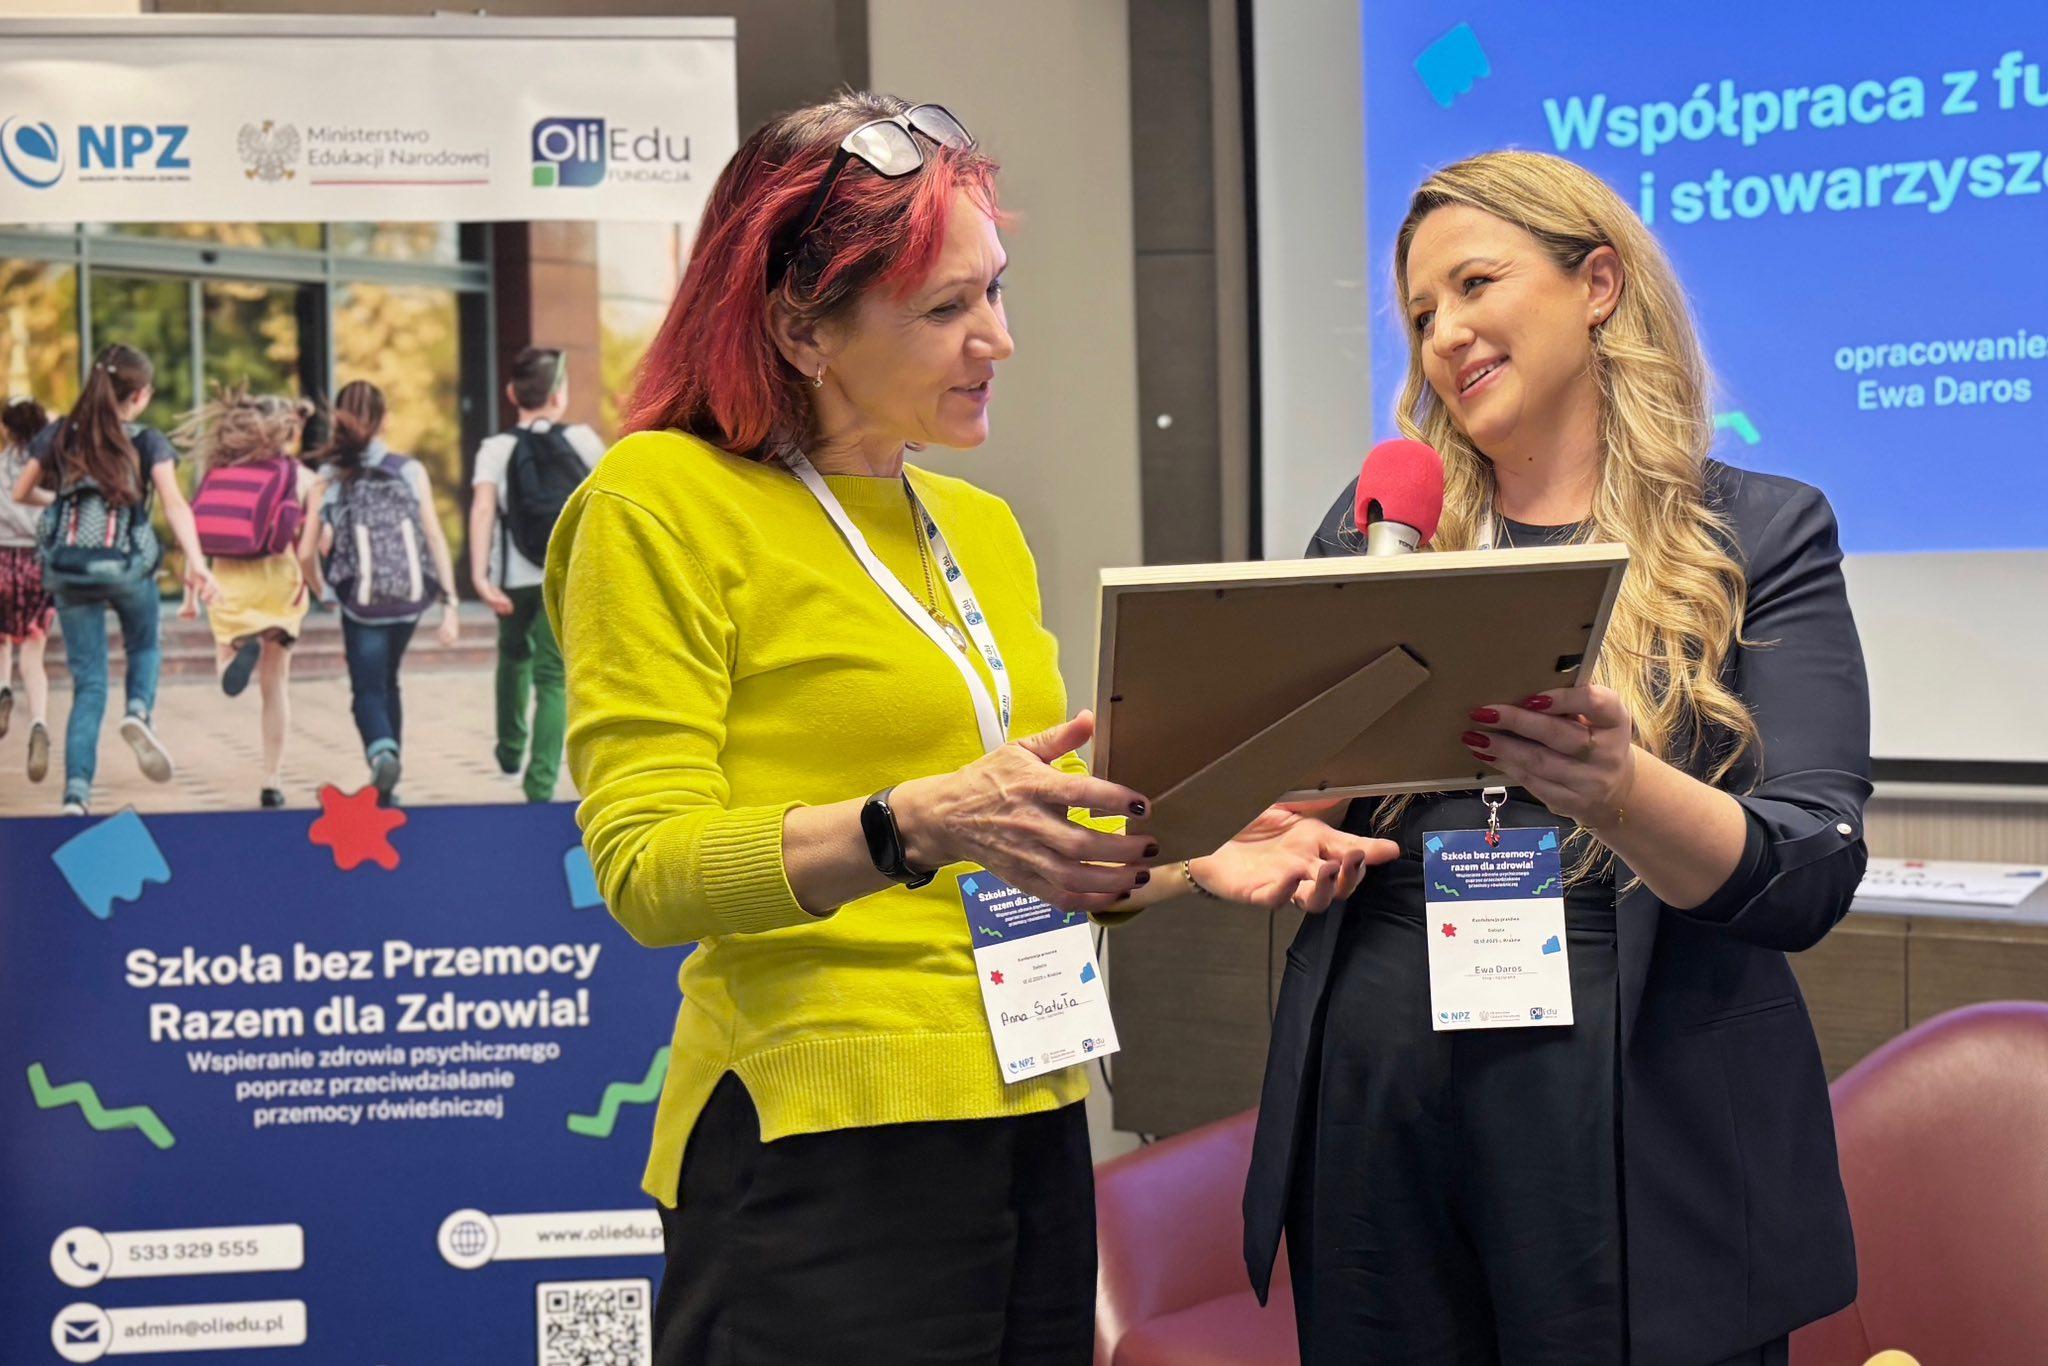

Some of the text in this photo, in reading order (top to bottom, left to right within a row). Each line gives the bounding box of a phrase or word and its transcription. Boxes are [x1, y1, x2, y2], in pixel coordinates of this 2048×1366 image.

[1543, 75, 1926, 156] Współpraca
[1940, 69, 1979, 116] z
[307, 126, 430, 144] Ministerstwo
[78, 124, 190, 169] NPZ
[308, 148, 490, 169] Edukacji Narodowej
[609, 169, 691, 182] FUNDACJA
[1640, 151, 2048, 227] i stowarzysz
[1834, 328, 2048, 375] opracowanie
[1857, 374, 2033, 411] Ewa Daros
[1441, 851, 1473, 861] Szkoła
[1474, 851, 1490, 860] bez
[1491, 850, 1535, 861] przemocy
[1450, 860, 1534, 872] razem dla zdrowia!
[978, 889, 1007, 902] Szkoła
[989, 900, 1015, 912] razem
[1014, 896, 1028, 907] dla
[125, 940, 601, 988] Szkoła bez Przemocy
[1474, 964, 1523, 974] Ewa Daros
[150, 988, 590, 1042] Razem dla Zdrowia!
[1001, 1012, 1029, 1026] Anna
[1451, 1011, 1471, 1020] NPZ
[186, 1040, 561, 1075] Wspieranie zdrowia psychicznego
[1018, 1056, 1036, 1069] NPZ
[236, 1067, 515, 1102] poprzez przeciwdziałanie
[253, 1094, 504, 1129] przemocy rówieśniczej
[129, 1240, 259, 1262] 533 329 555
[124, 1314, 284, 1338] admin@oliedu.pl
